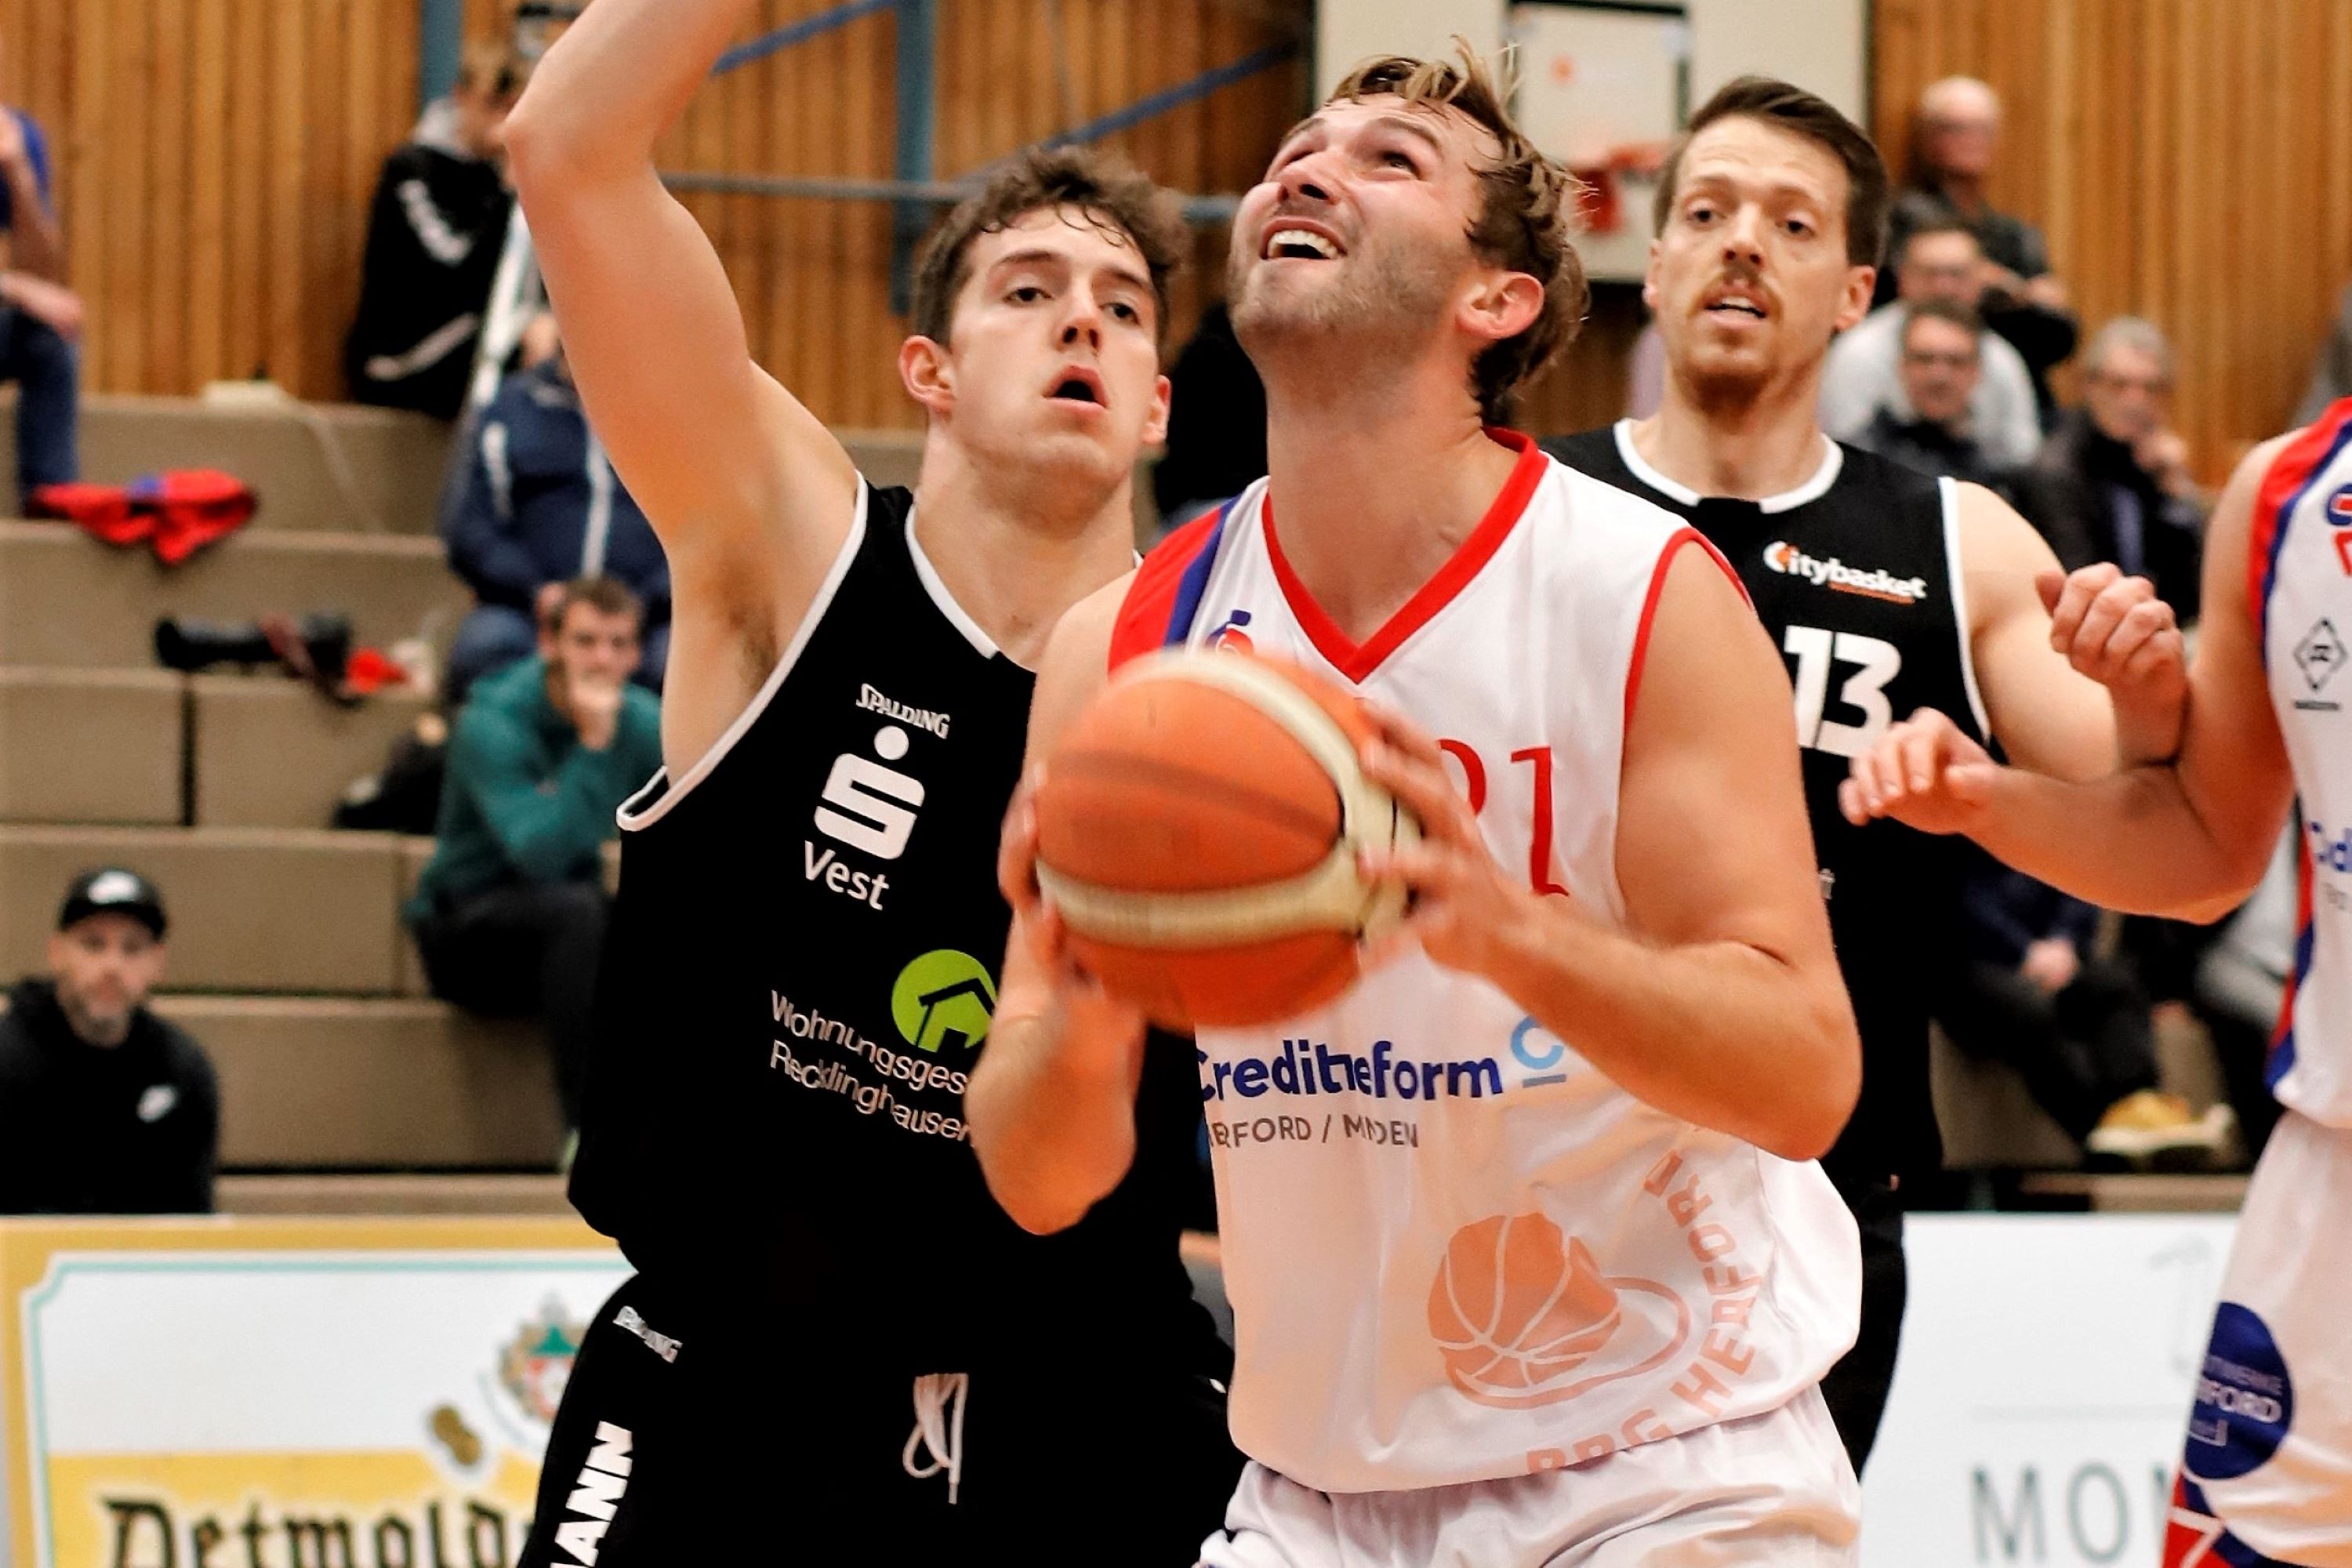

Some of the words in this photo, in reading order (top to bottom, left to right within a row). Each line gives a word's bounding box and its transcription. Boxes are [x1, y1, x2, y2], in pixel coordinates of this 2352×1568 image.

[1763, 541, 1927, 599] Citybasket
[855, 682, 950, 739] SPALDING
[1784, 625, 1902, 757] 13
[804, 840, 890, 910] Vest
[102, 1496, 537, 1568] Detmold
